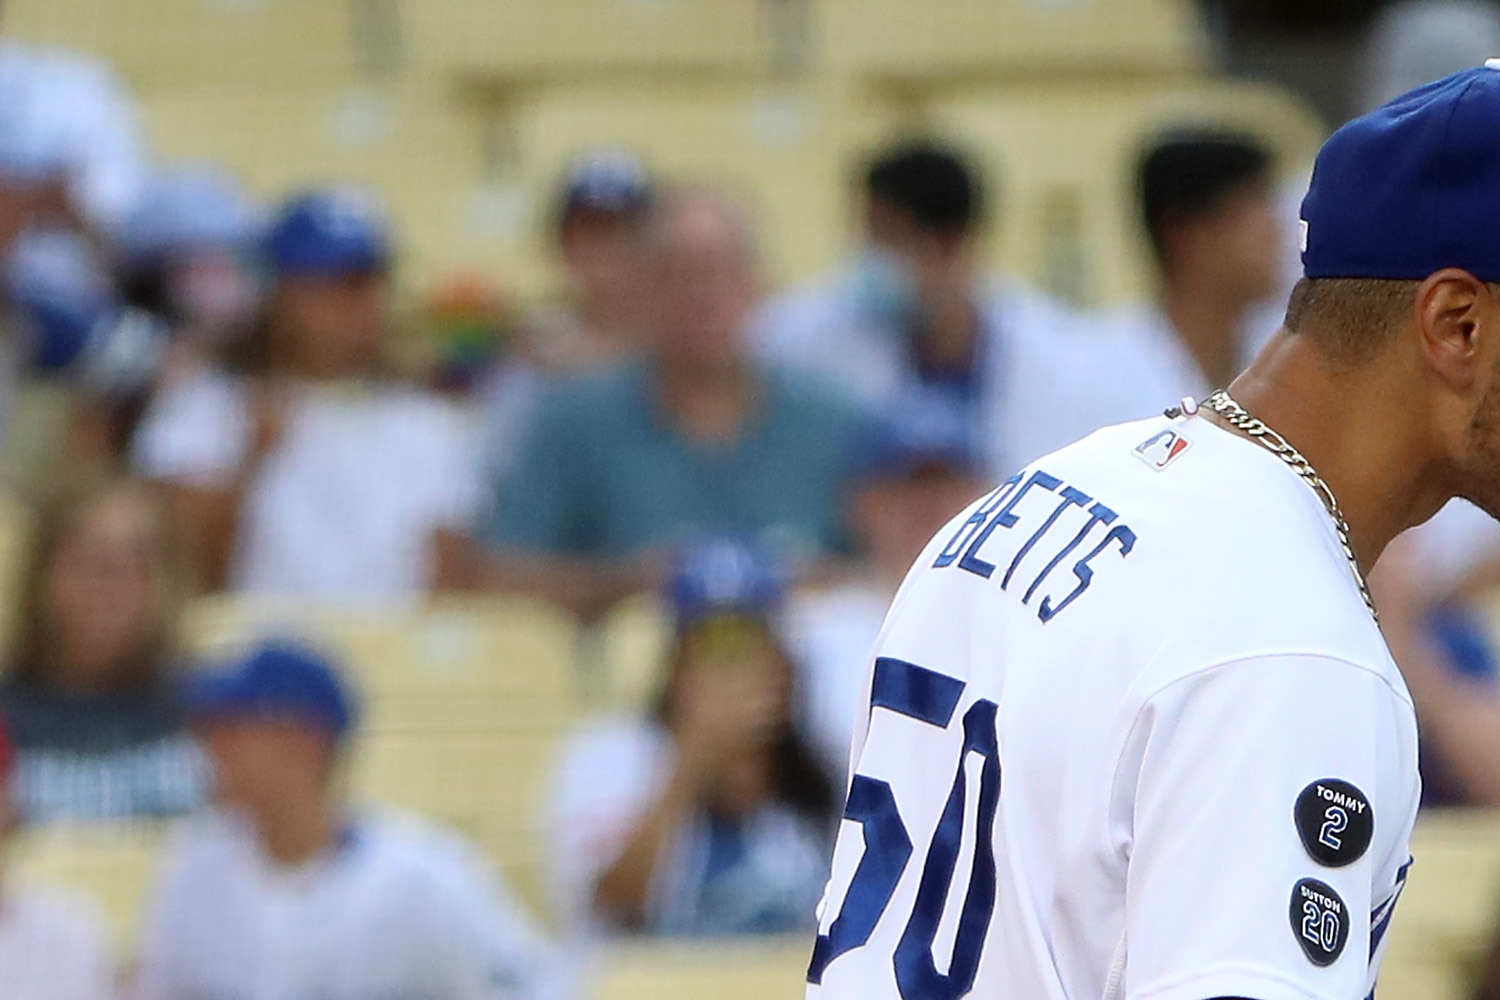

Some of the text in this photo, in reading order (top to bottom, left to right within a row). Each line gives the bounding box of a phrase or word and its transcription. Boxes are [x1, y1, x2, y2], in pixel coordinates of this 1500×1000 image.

[931, 470, 1138, 625] BETTS
[1316, 785, 1366, 815] TOMMY
[1318, 805, 1349, 851] 2
[1300, 885, 1342, 914] SUTTON
[1301, 900, 1340, 952] 20
